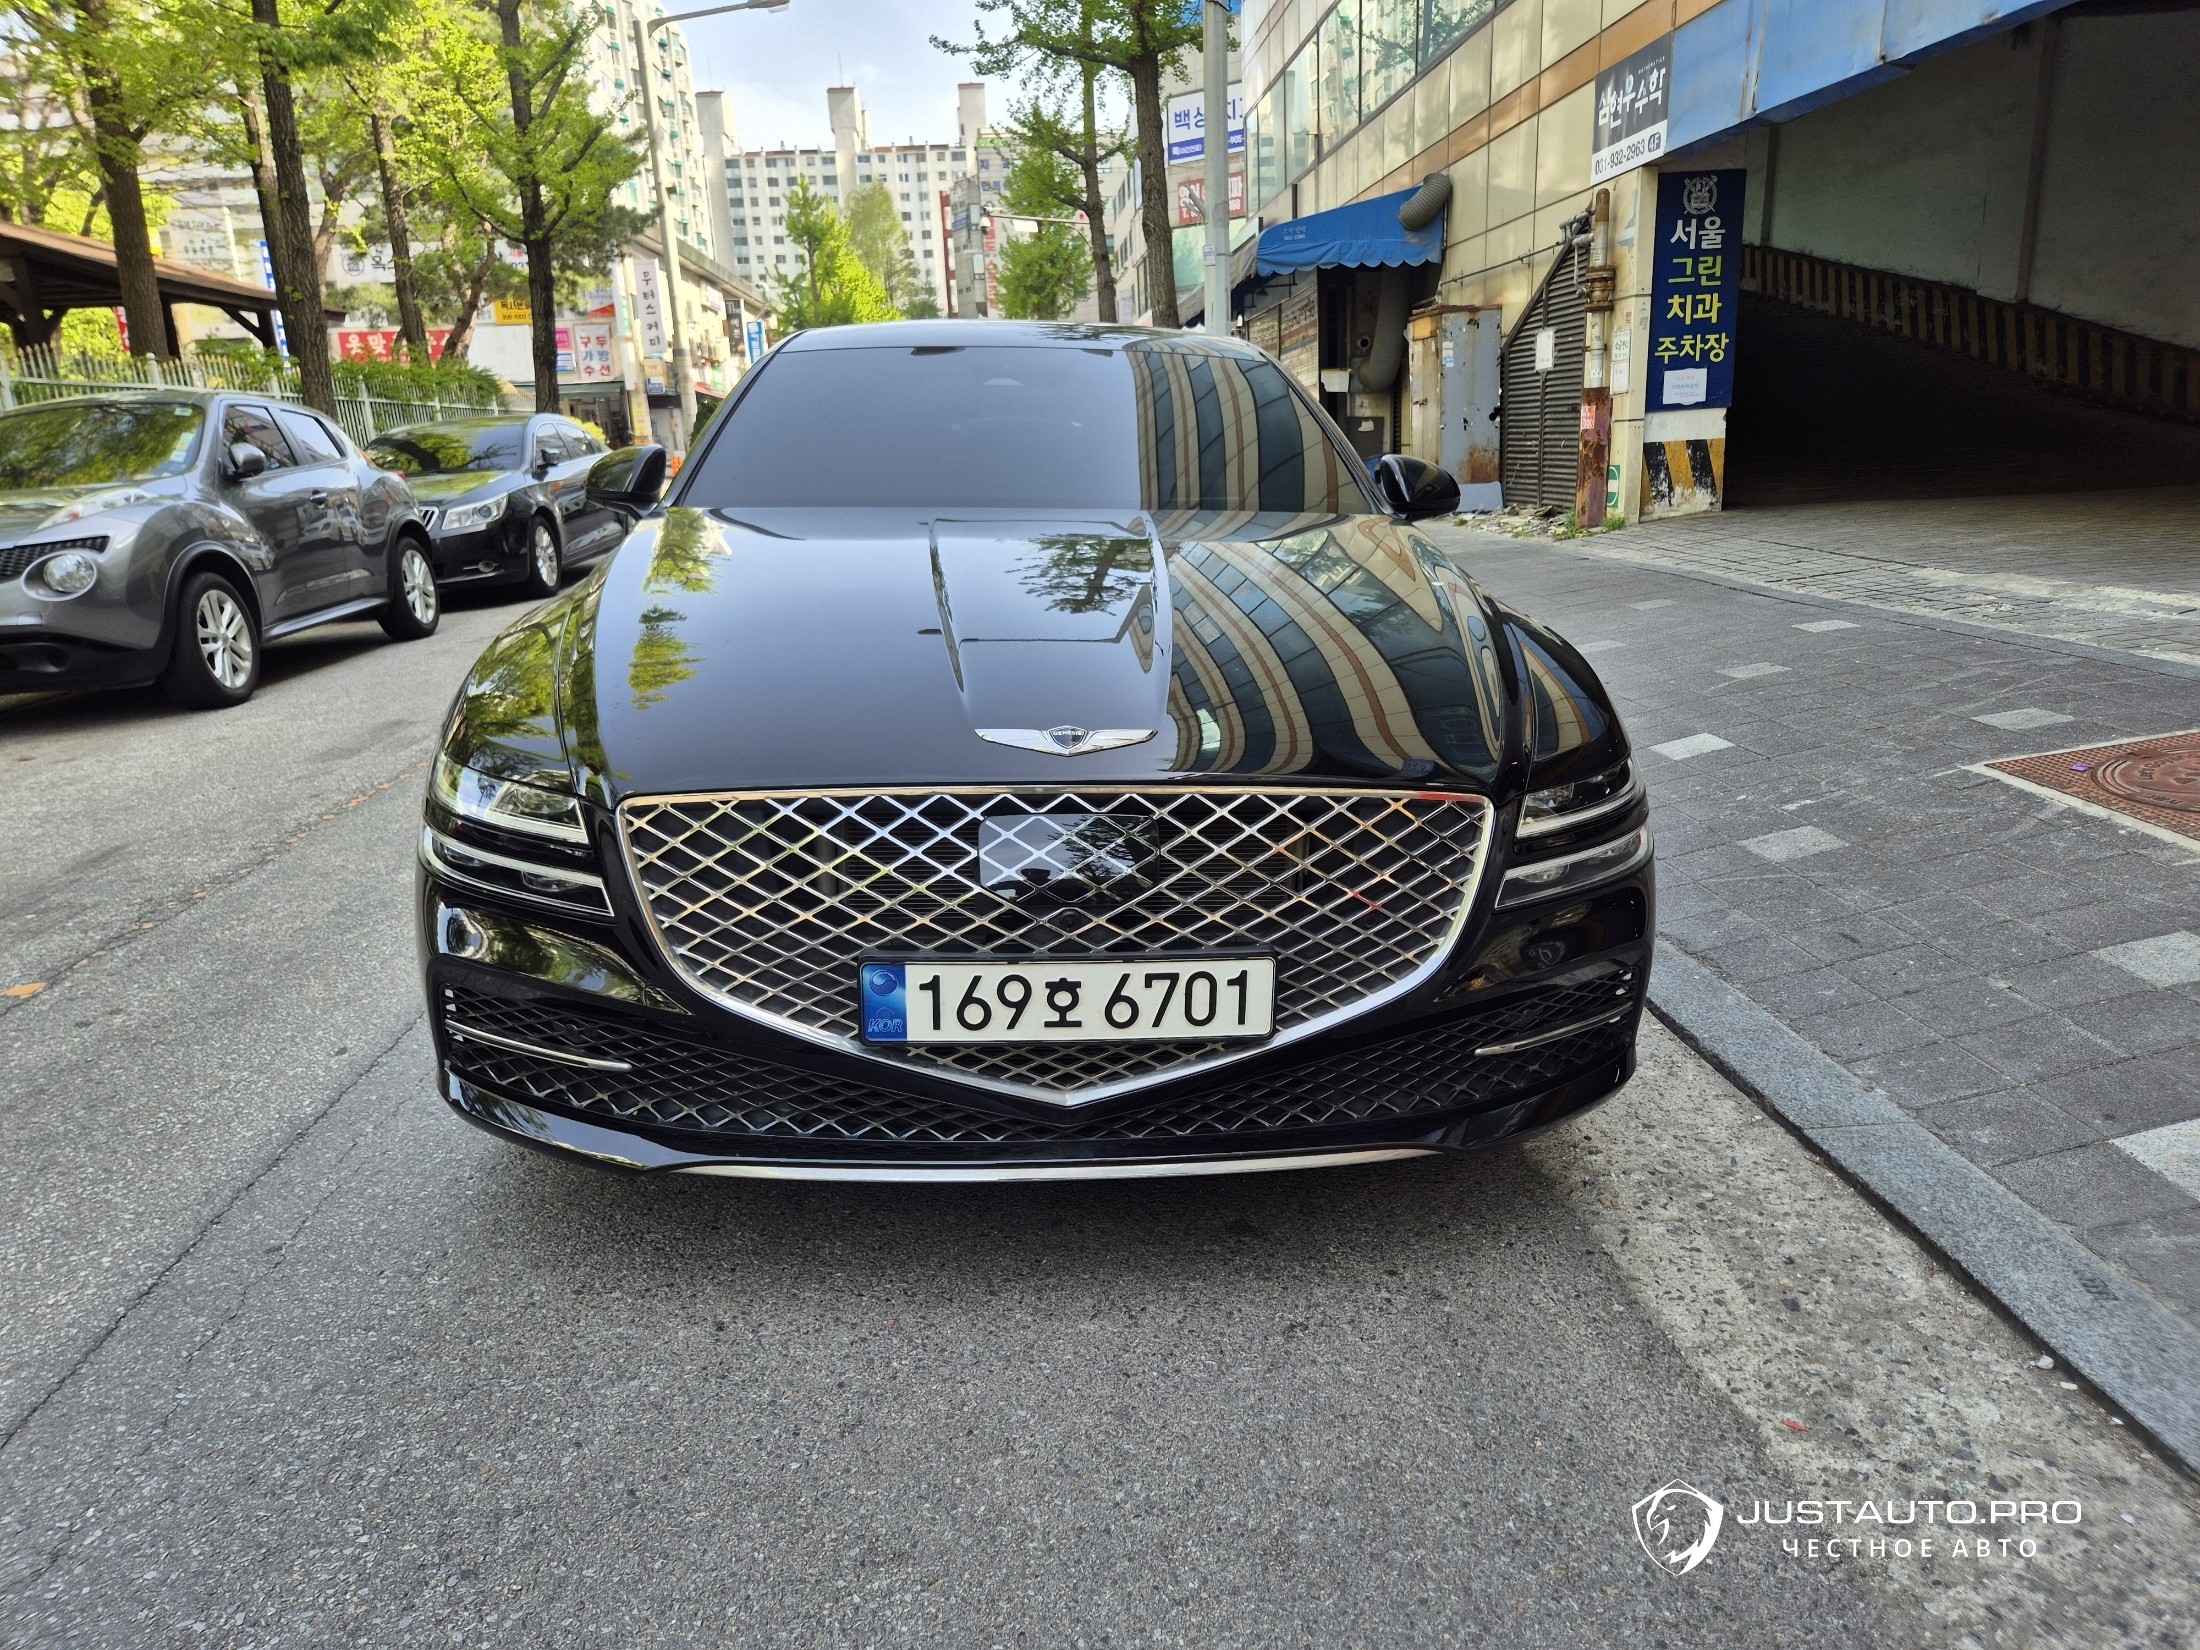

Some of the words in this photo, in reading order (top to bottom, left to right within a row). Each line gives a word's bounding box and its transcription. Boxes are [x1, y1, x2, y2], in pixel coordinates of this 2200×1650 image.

[1595, 138, 1646, 175] 031-932-2963
[1648, 133, 1661, 153] 4F
[1670, 215, 1726, 250] 서울
[1667, 255, 1722, 287] 그린
[1666, 292, 1722, 325] 치과
[579, 336, 608, 348] 구두
[1654, 332, 1729, 364] 주차장
[584, 364, 612, 377] 수선
[919, 974, 1082, 1031] 169호
[1104, 970, 1248, 1029] 6701
[867, 1018, 903, 1033] KOR
